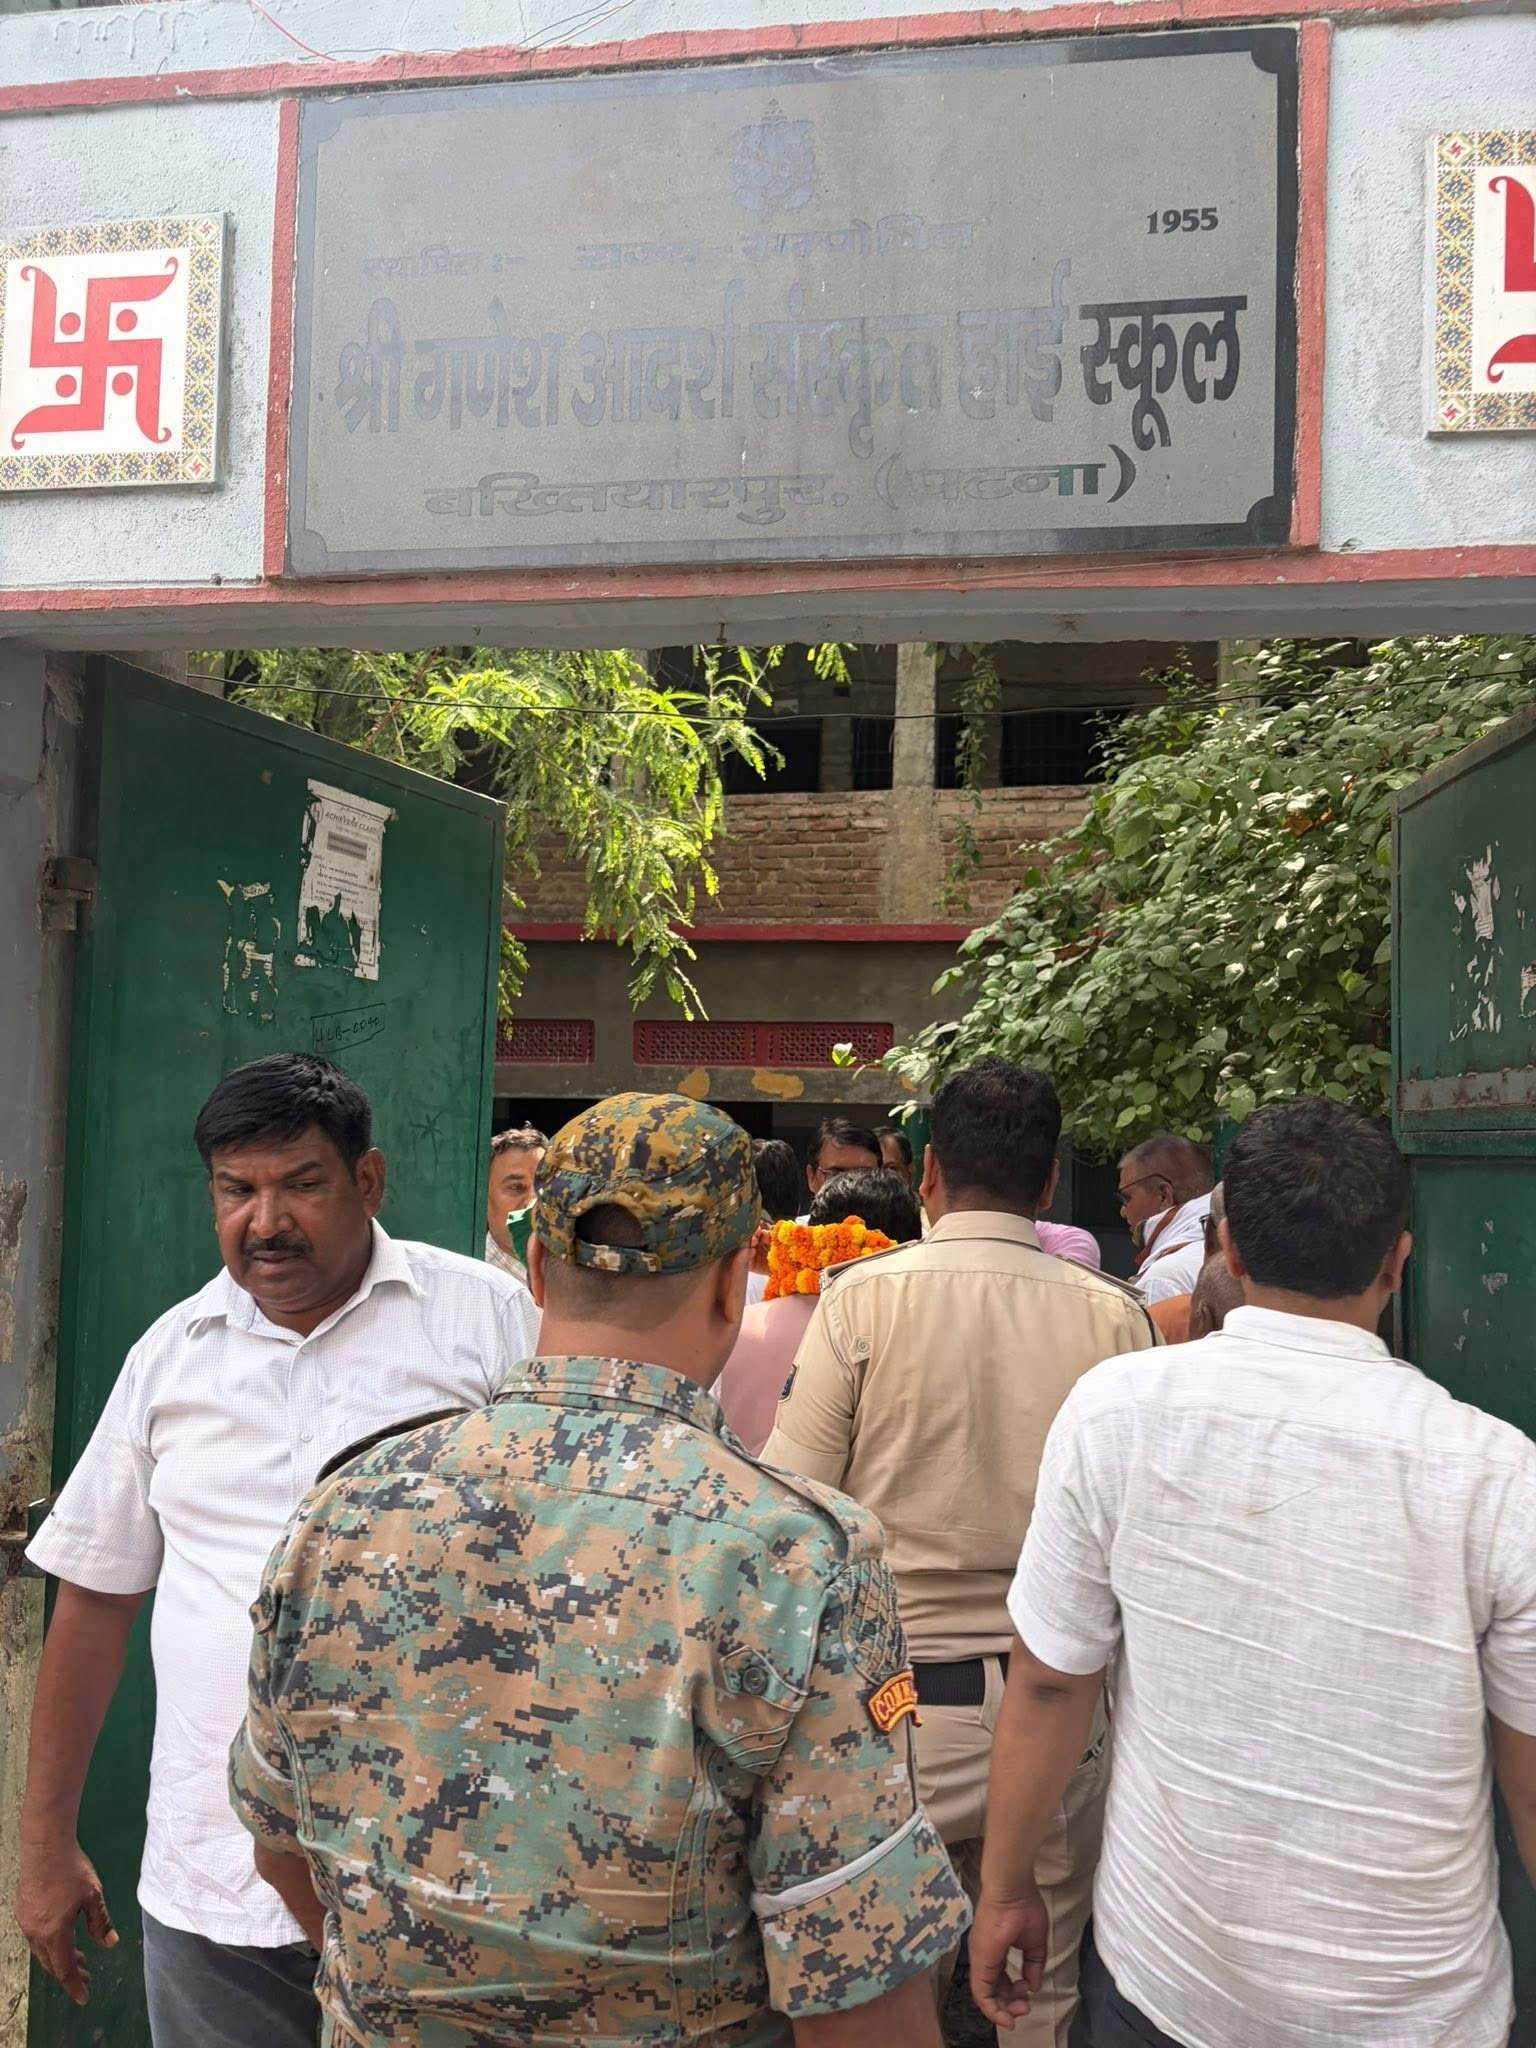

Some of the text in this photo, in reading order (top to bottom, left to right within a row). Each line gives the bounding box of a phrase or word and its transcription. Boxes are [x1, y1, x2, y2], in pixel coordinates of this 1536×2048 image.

[1146, 207, 1219, 235] 1955
[334, 297, 403, 433] श्री
[413, 294, 566, 431] गणेश
[570, 278, 741, 427] आदर्श
[957, 258, 1071, 422] हाई
[1079, 295, 1248, 452] स्कूल
[874, 443, 1137, 510] (पटना)
